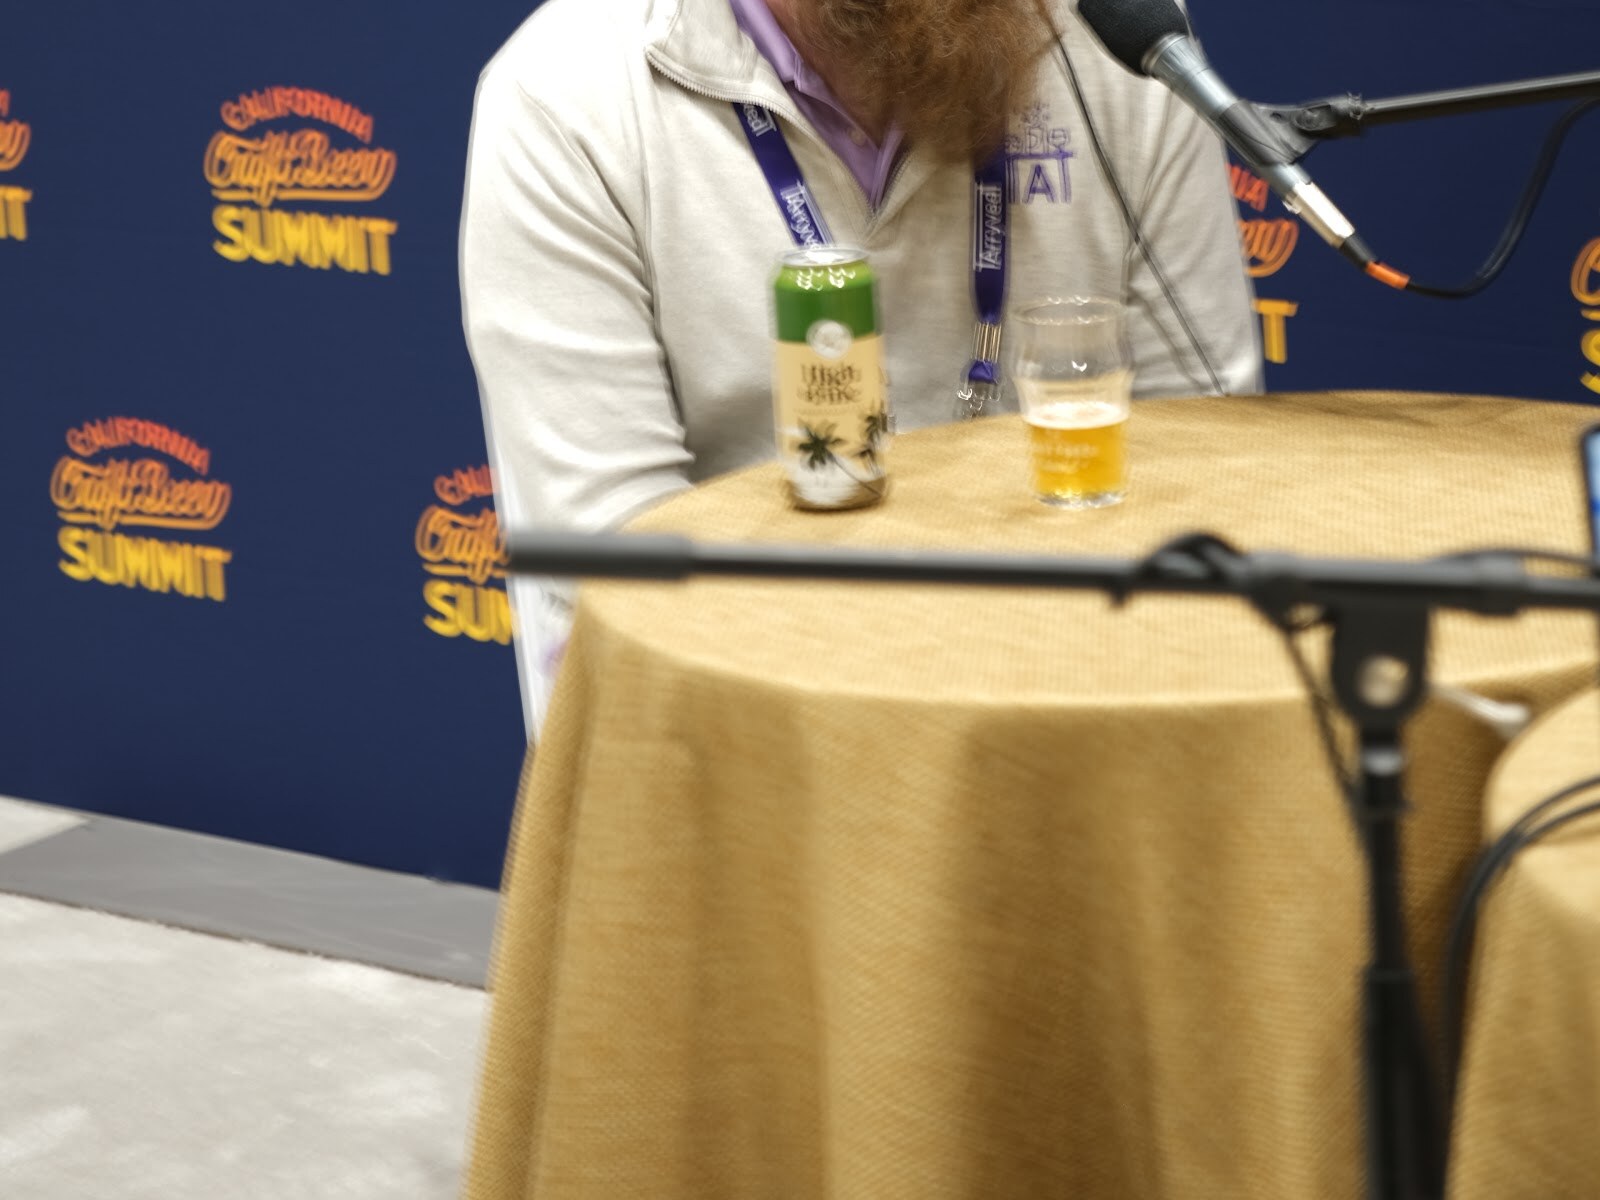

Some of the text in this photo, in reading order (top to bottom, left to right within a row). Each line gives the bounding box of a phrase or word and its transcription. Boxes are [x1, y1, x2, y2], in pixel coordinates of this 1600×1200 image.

[220, 86, 374, 143] CALIFORNIA
[211, 204, 398, 275] SUMMIT
[66, 416, 211, 475] CALIFORNIA
[58, 526, 233, 601] SUMMIT
